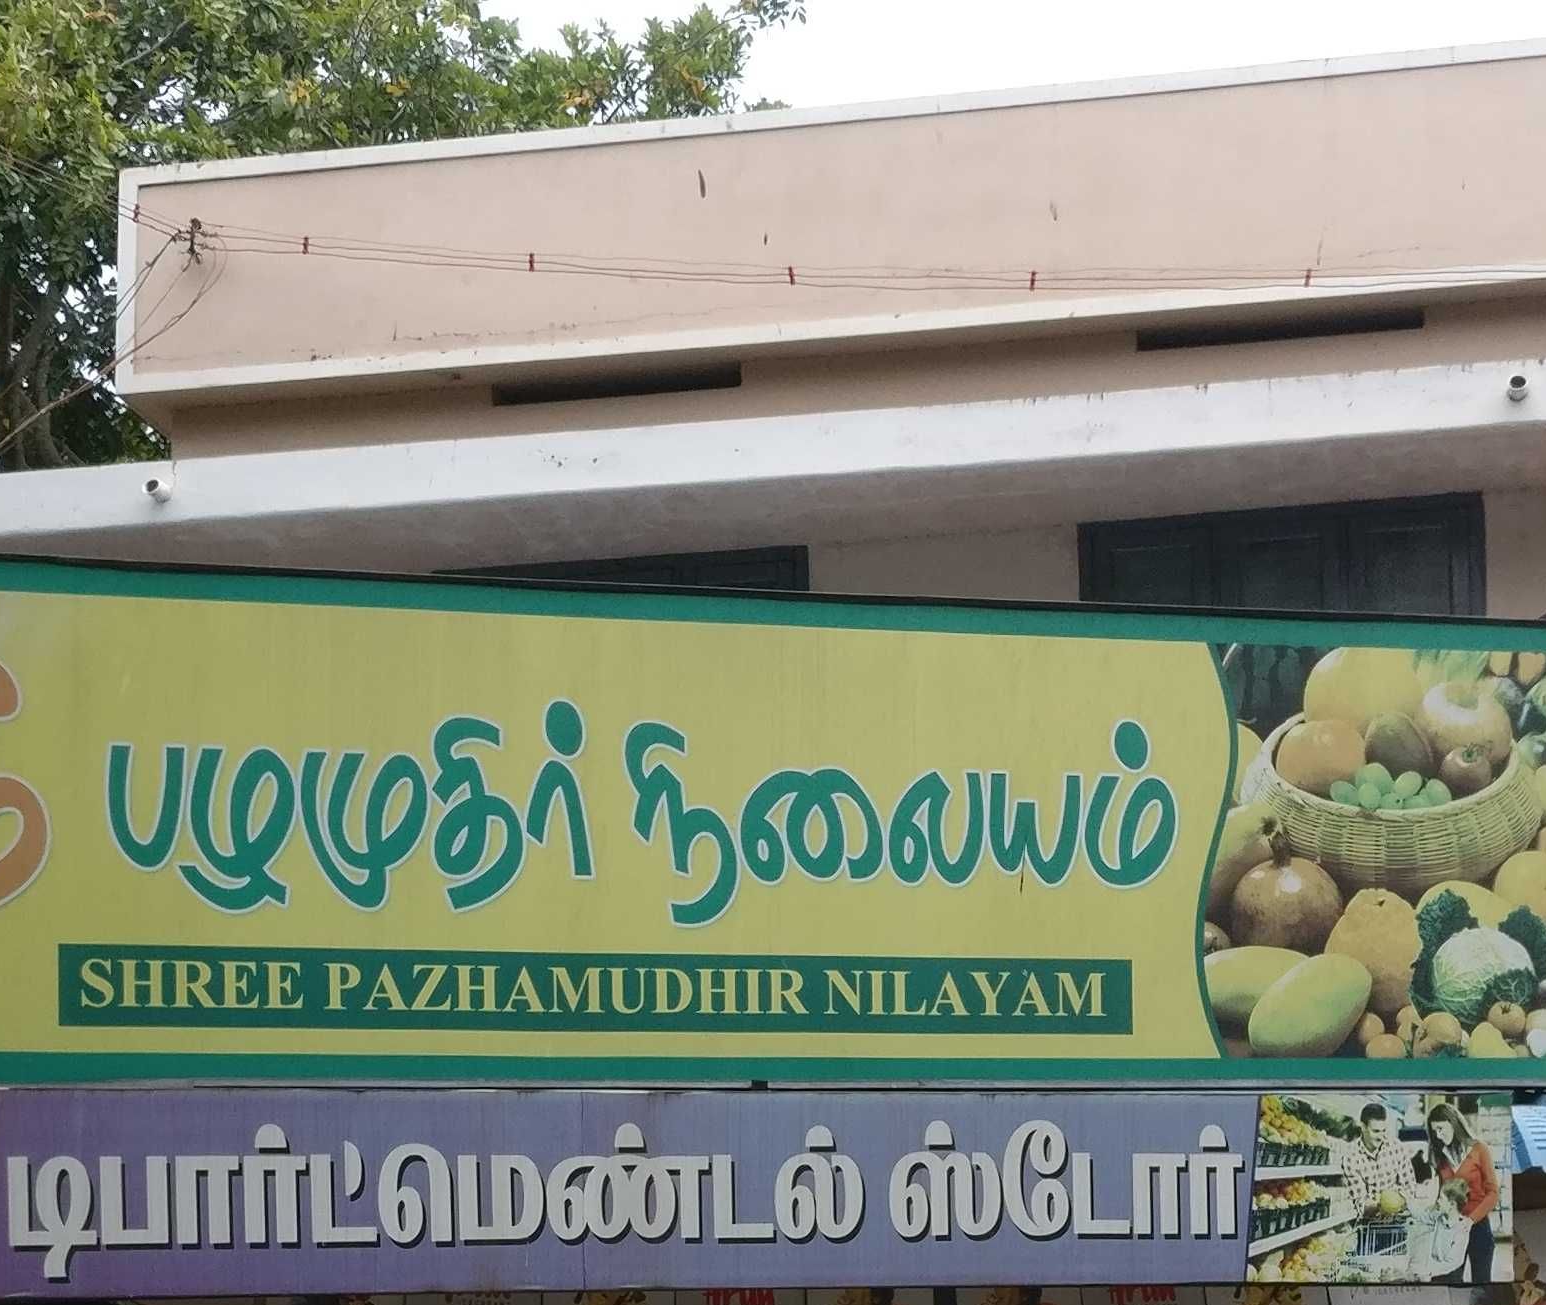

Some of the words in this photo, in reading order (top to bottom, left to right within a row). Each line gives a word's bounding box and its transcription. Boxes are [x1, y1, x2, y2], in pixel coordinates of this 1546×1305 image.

[107, 700, 594, 916] பழமுதிர்
[624, 719, 1179, 927] நிலையம்
[79, 957, 305, 1012] SHREE
[326, 960, 807, 1018] PAZHAMUDHIR
[826, 970, 1107, 1018] NILAYAM
[6, 1123, 860, 1281] டிபார்ட்மெண்டல்
[889, 1118, 1243, 1243] ஸ்டோர்
